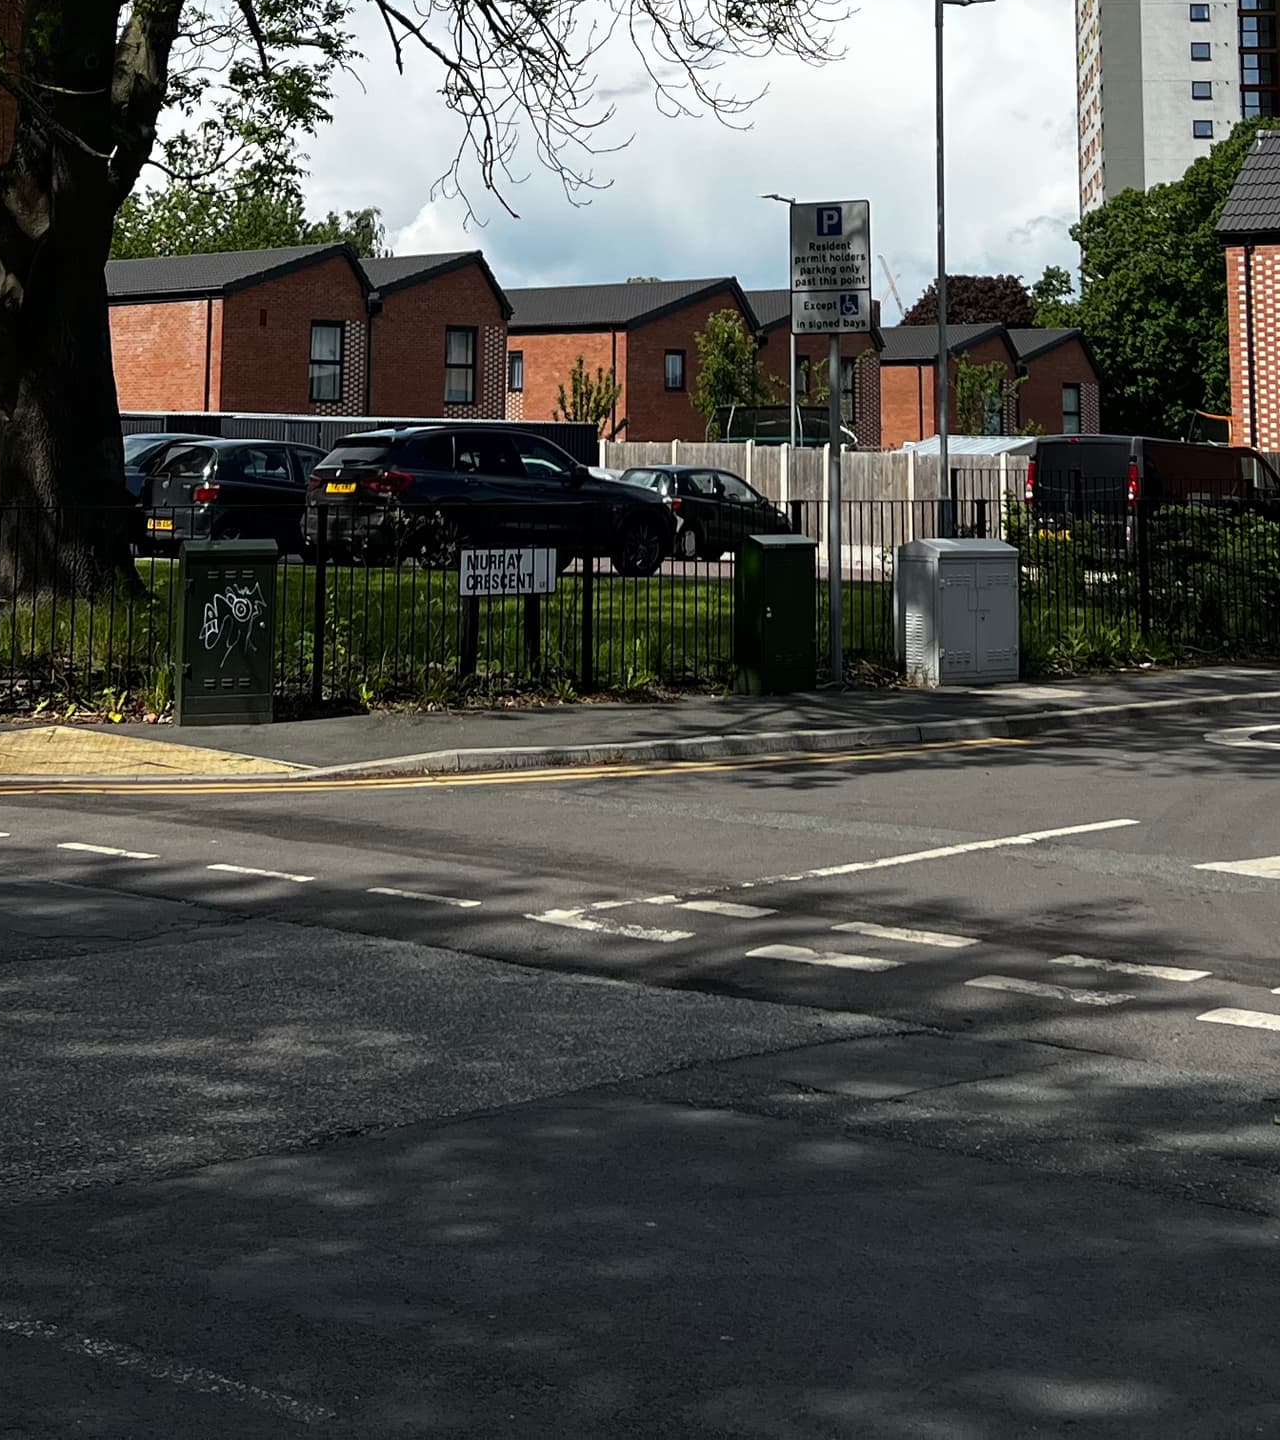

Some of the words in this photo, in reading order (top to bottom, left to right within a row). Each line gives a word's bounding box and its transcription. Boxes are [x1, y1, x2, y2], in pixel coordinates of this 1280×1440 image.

[822, 210, 839, 233] P
[809, 242, 851, 251] Resident
[795, 253, 827, 264] permit
[829, 253, 866, 261] holders
[800, 264, 837, 276] parking
[840, 264, 860, 275] only
[795, 277, 816, 288] past
[820, 276, 837, 285] this
[840, 275, 866, 286] point
[804, 300, 837, 311] Except
[797, 320, 806, 328] in
[809, 318, 840, 329] signed
[844, 318, 866, 329] bays
[466, 573, 533, 590] CRESCENT
